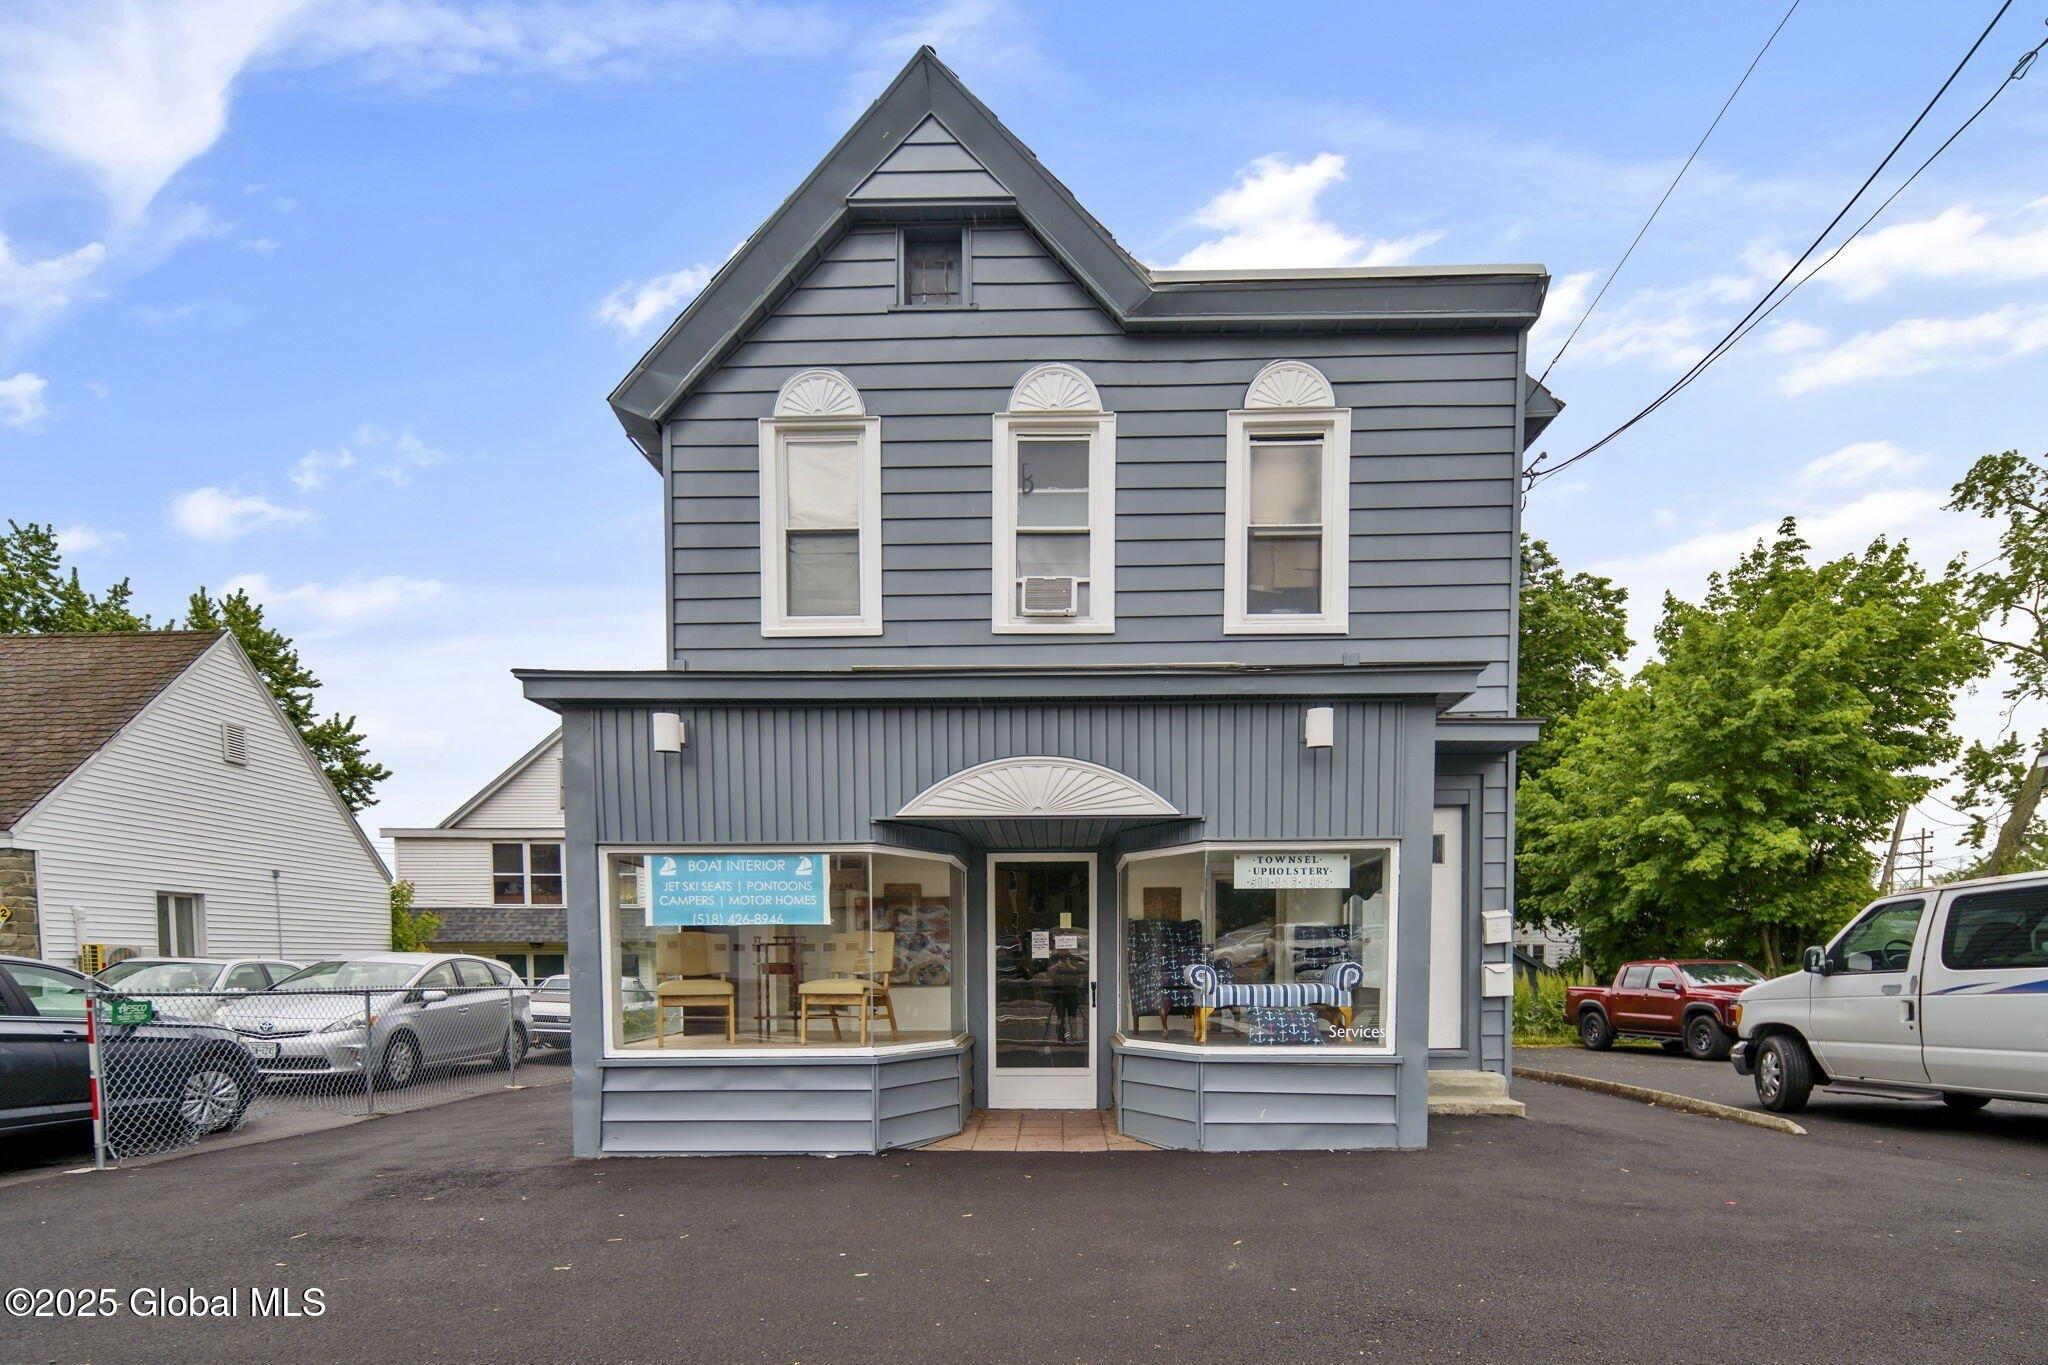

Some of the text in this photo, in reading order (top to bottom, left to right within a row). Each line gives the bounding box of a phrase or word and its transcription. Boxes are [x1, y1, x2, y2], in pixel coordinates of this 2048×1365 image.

[688, 859, 786, 872] BOAT INTERIOR
[663, 881, 681, 892] JET
[682, 881, 699, 892] SKI
[701, 881, 733, 892] SEATS
[746, 881, 813, 892] PONTOONS
[659, 895, 715, 906] CAMPERS
[729, 895, 773, 906] MOTOR
[775, 895, 817, 906] HOMES
[692, 913, 785, 925] (518) 426-8946
[1328, 1024, 1386, 1038] Services
